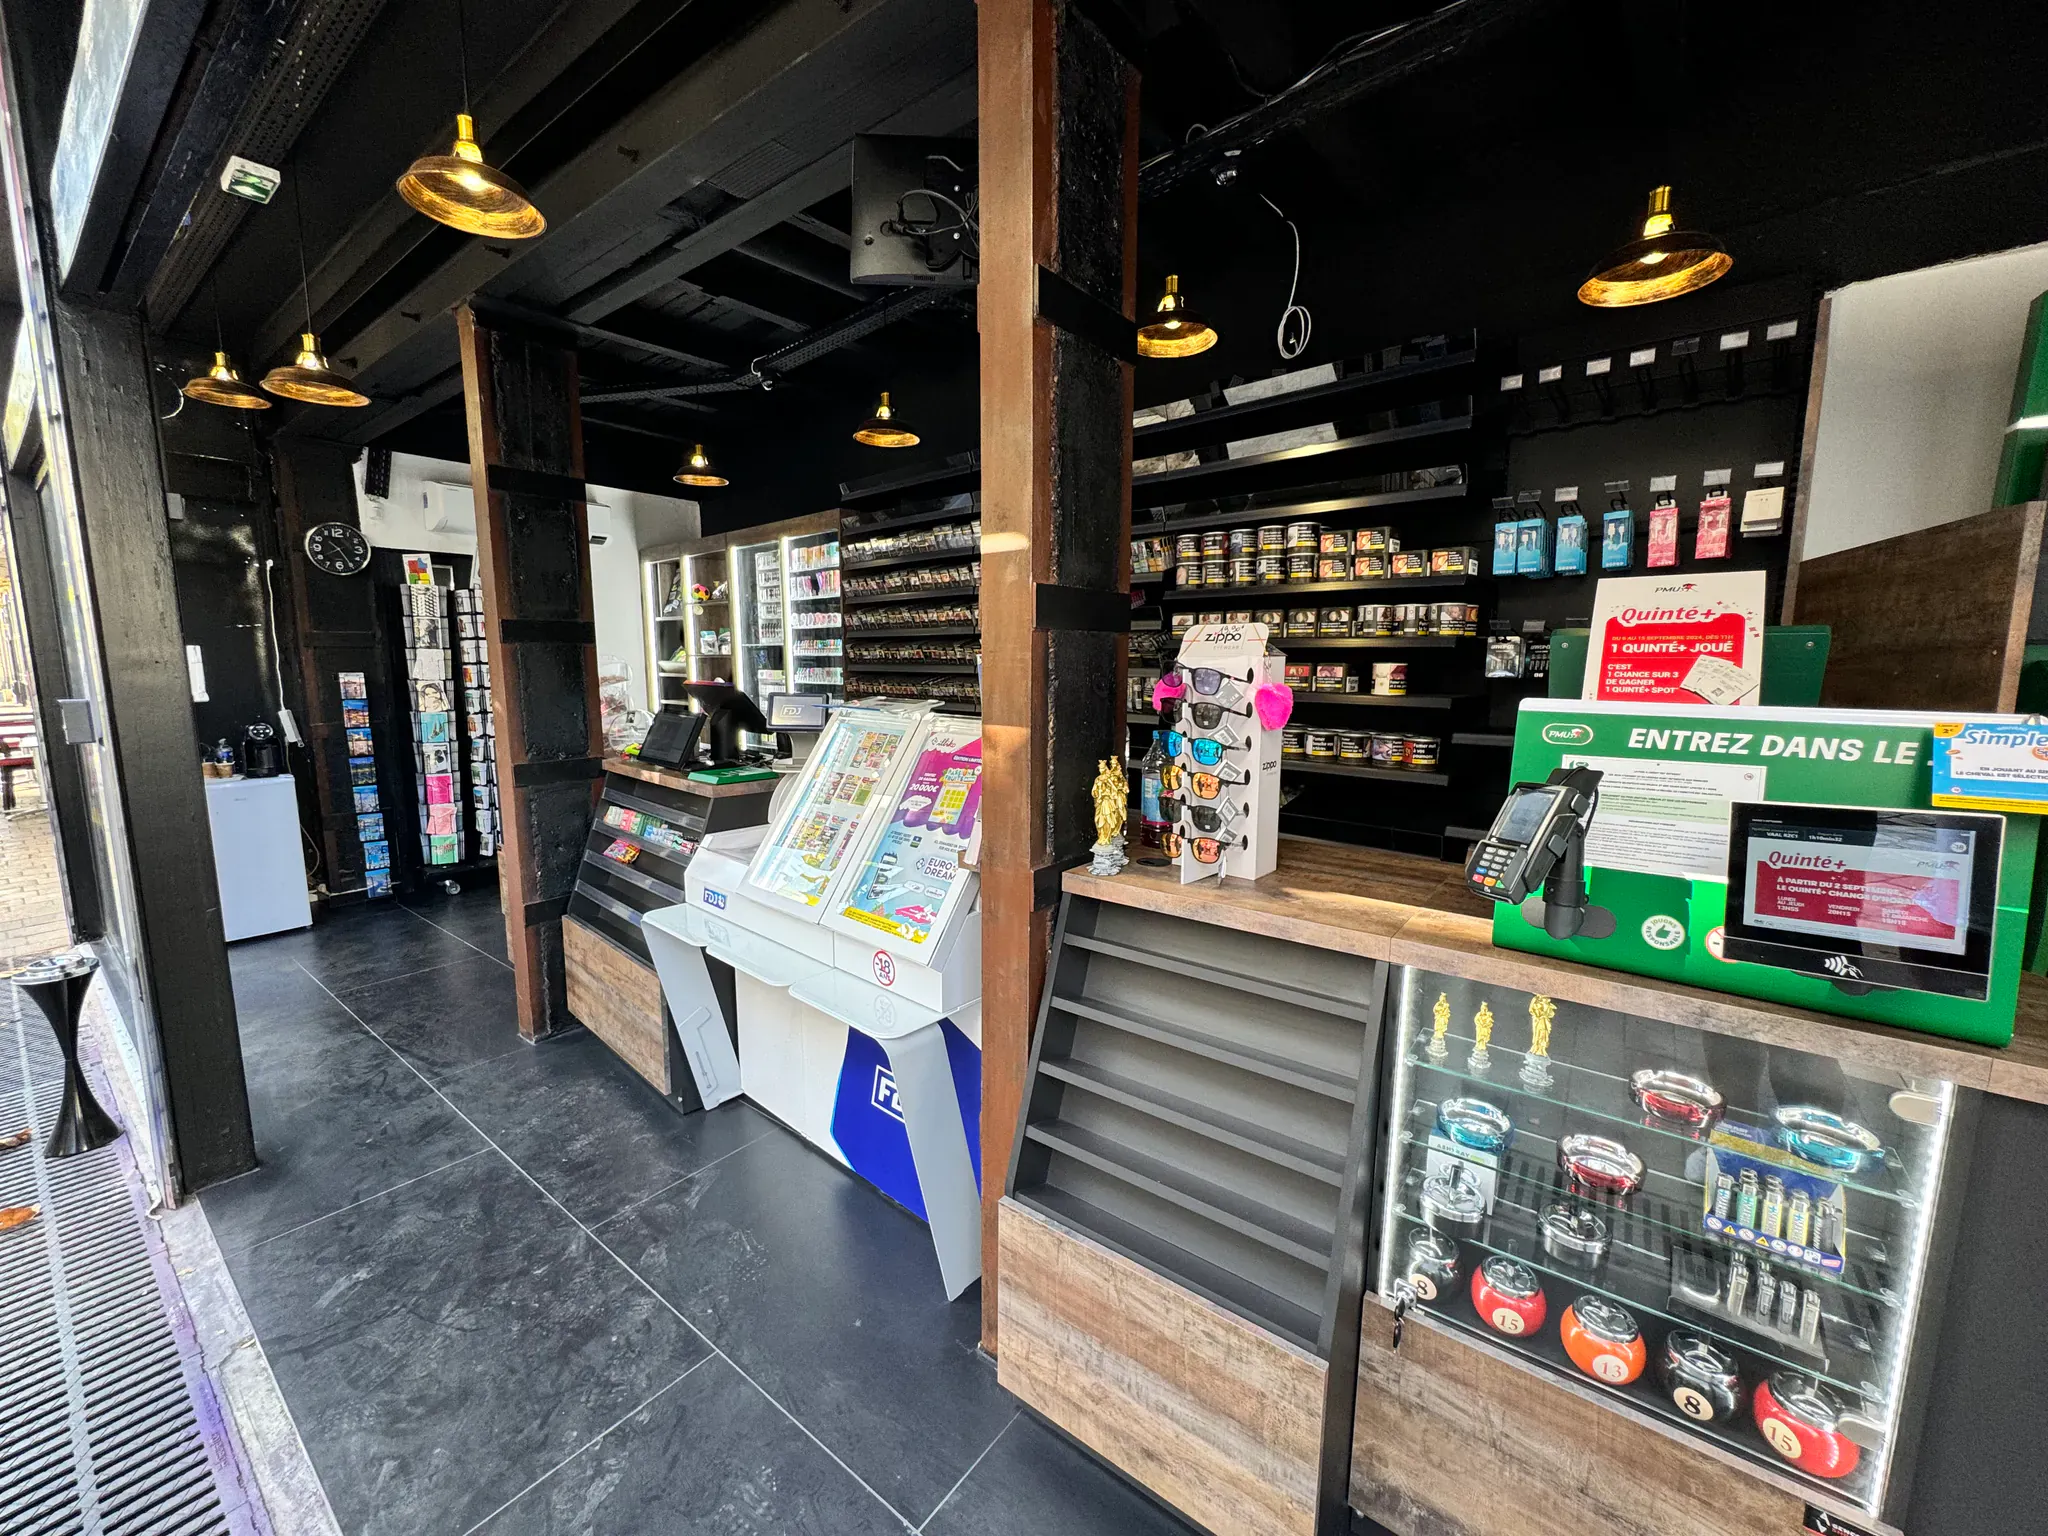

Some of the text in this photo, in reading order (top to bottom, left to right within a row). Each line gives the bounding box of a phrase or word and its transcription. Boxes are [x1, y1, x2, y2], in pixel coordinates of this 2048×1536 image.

[331, 528, 344, 538] 12
[312, 543, 322, 552] 9
[354, 546, 364, 554] 3
[336, 561, 344, 570] 6
[1654, 586, 1681, 594] PMU
[1621, 606, 1716, 622] Quinté+
[1612, 641, 1733, 653] 1 QUINTÉ+ JOUÉ
[1612, 685, 1650, 693] QUINTÉ+
[1548, 730, 1571, 739] PMU
[1628, 728, 1920, 764] ENTREZ DANS LE
[927, 858, 952, 870] EURO
[1768, 850, 1847, 869] Quinté+
[1785, 877, 1818, 886] PARTIR
[704, 892, 720, 904] FDJ
[1788, 885, 1827, 895] QUINTÉ+
[1828, 890, 1870, 900] CHANGE
[1828, 904, 1860, 912] VENDREDI
[1645, 926, 1680, 946] RESPONSABLE
[875, 958, 890, 974] -18
[1417, 1280, 1428, 1296] 8
[1500, 1315, 1518, 1330] 15
[1600, 1361, 1622, 1378] 13
[1684, 1395, 1700, 1416] 8
[1768, 1426, 1792, 1452] 15
